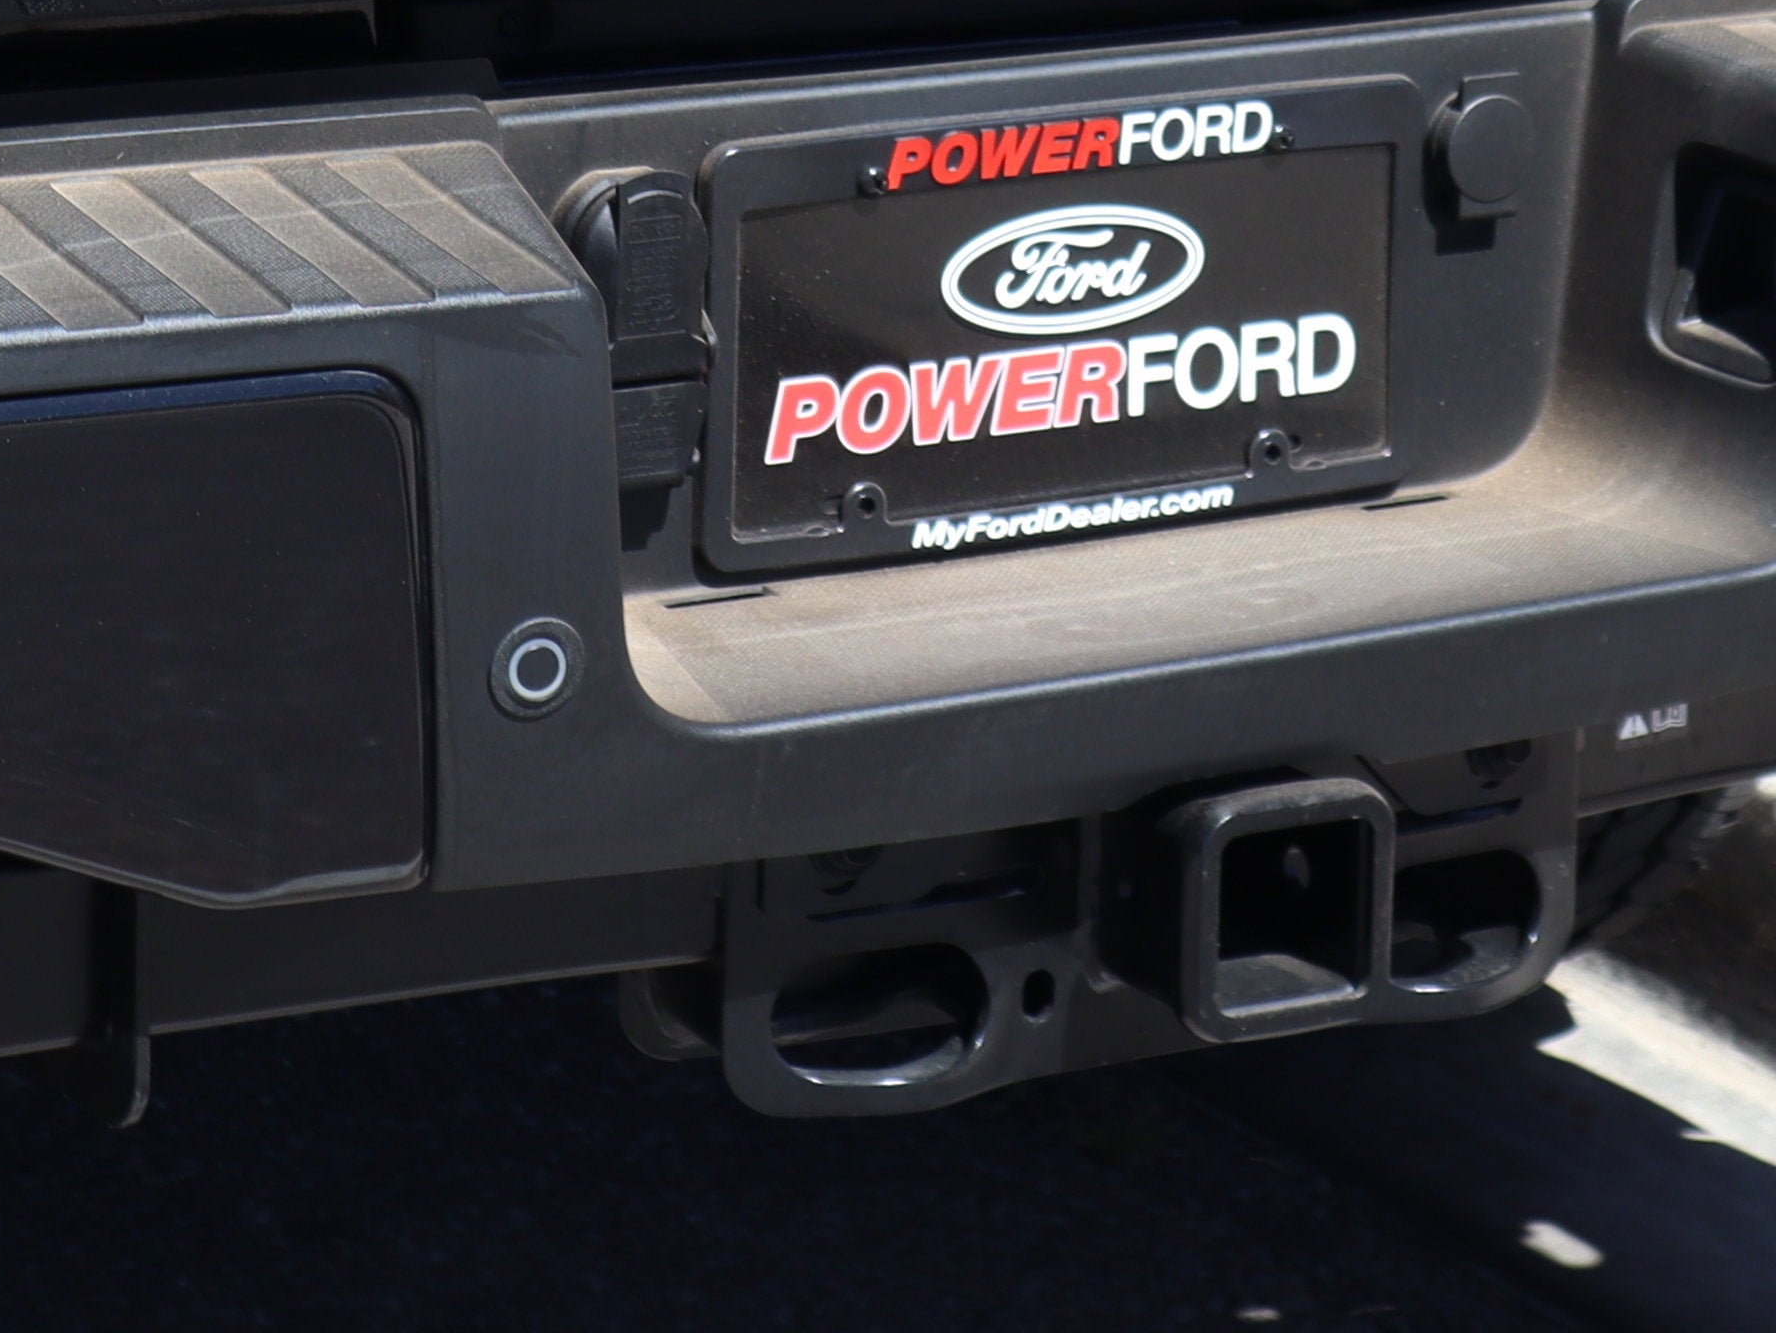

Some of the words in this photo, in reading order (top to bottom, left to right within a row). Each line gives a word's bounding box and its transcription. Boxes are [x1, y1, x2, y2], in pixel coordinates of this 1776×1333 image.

[887, 100, 1274, 191] POWERFORD
[994, 228, 1148, 307] Ford
[764, 312, 1357, 465] POWERFORD
[911, 485, 1234, 550] MyFordDealer.com
